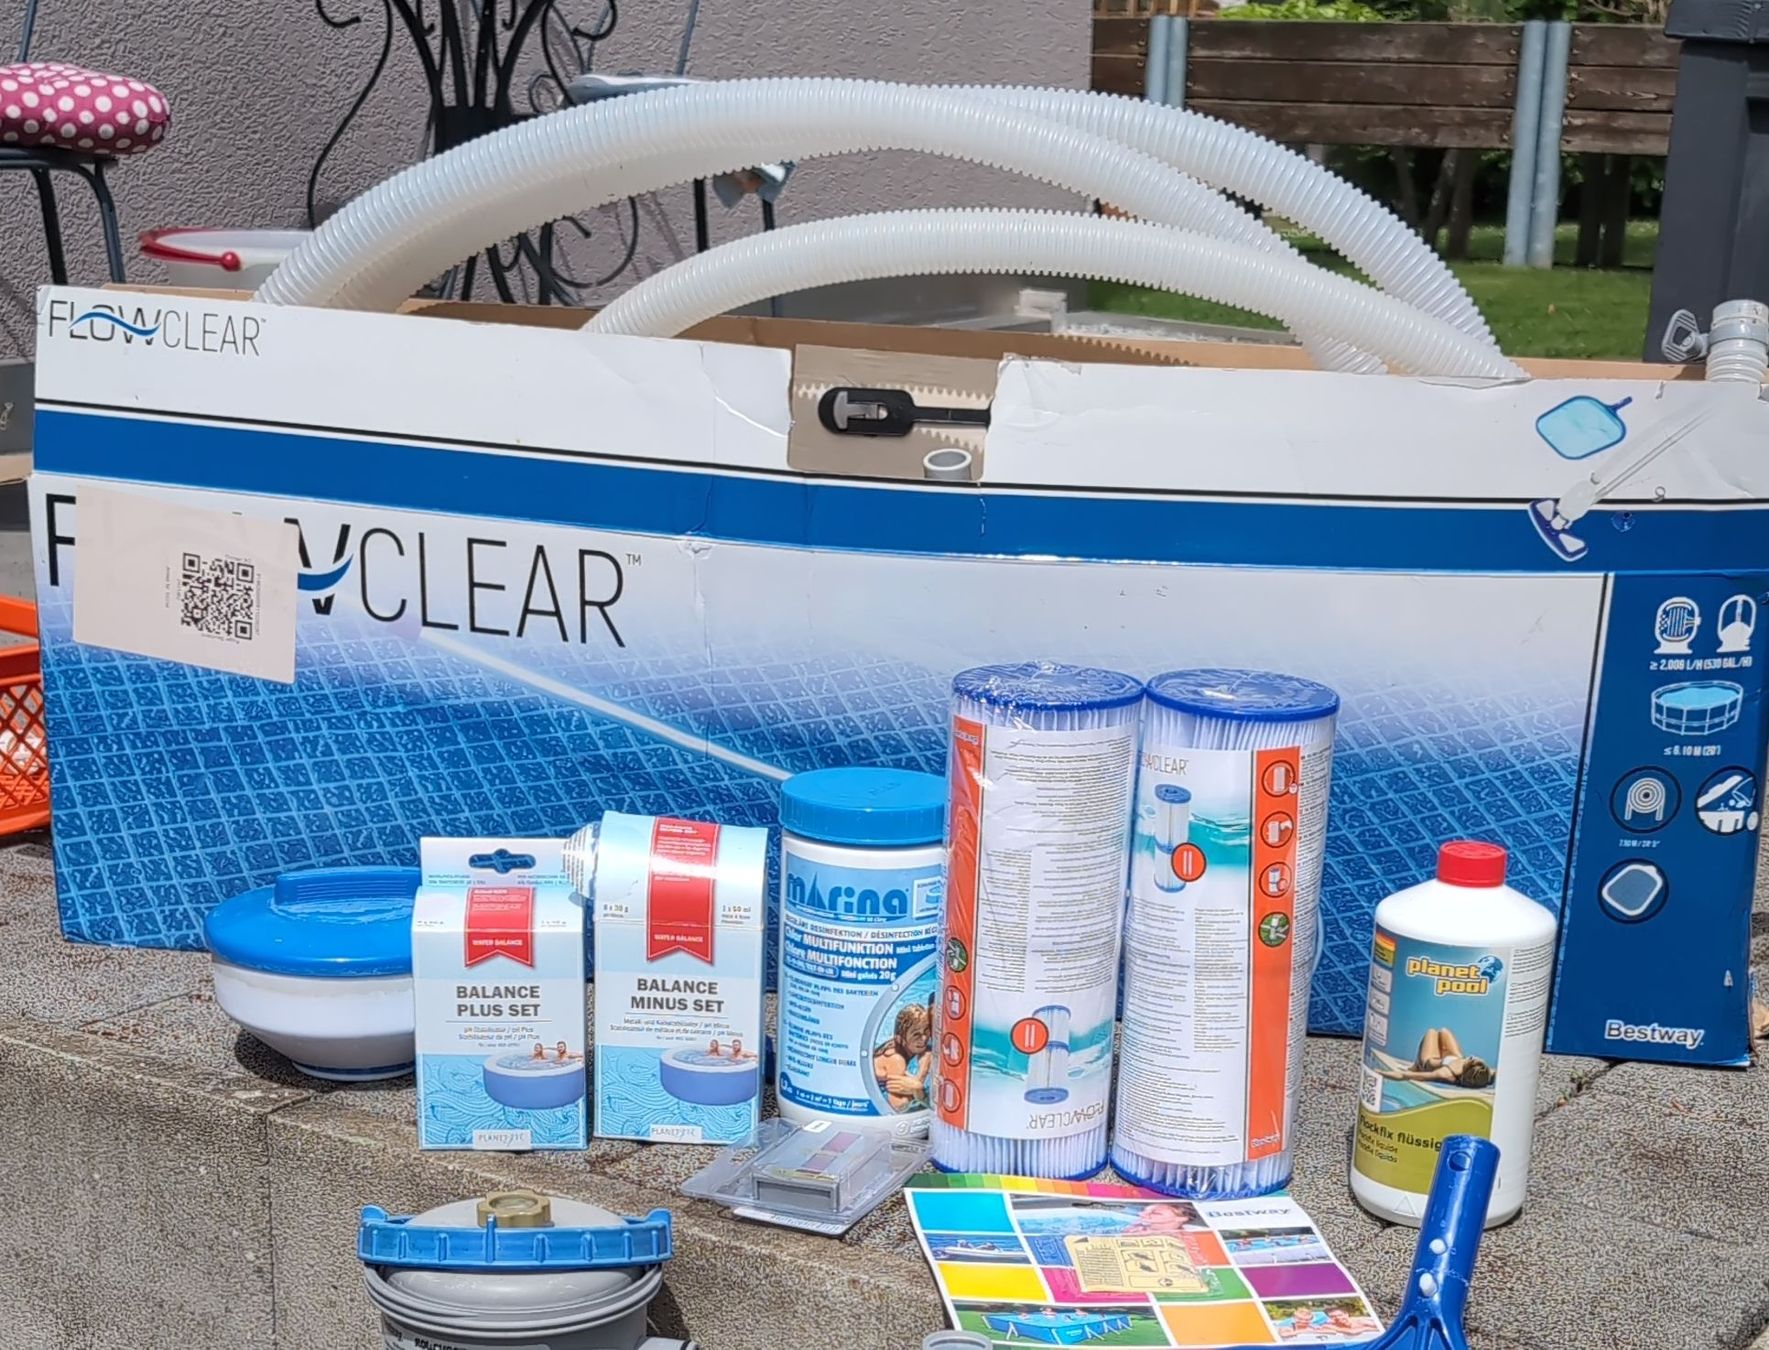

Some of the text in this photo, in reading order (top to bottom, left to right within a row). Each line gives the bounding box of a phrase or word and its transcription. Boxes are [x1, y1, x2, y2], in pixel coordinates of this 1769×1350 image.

[802, 934, 894, 954] MULTIFUNKTION
[806, 949, 898, 969] MULTIFONCTION
[1407, 958, 1480, 979] planet
[456, 985, 540, 999] BALANCE
[637, 978, 718, 995] BALANCE
[1436, 979, 1488, 994] pool
[457, 1004, 541, 1017] PLUS SET
[630, 996, 724, 1013] MINUS SET
[1605, 1019, 1705, 1049] Bestway
[1397, 1132, 1443, 1152] flüssig
